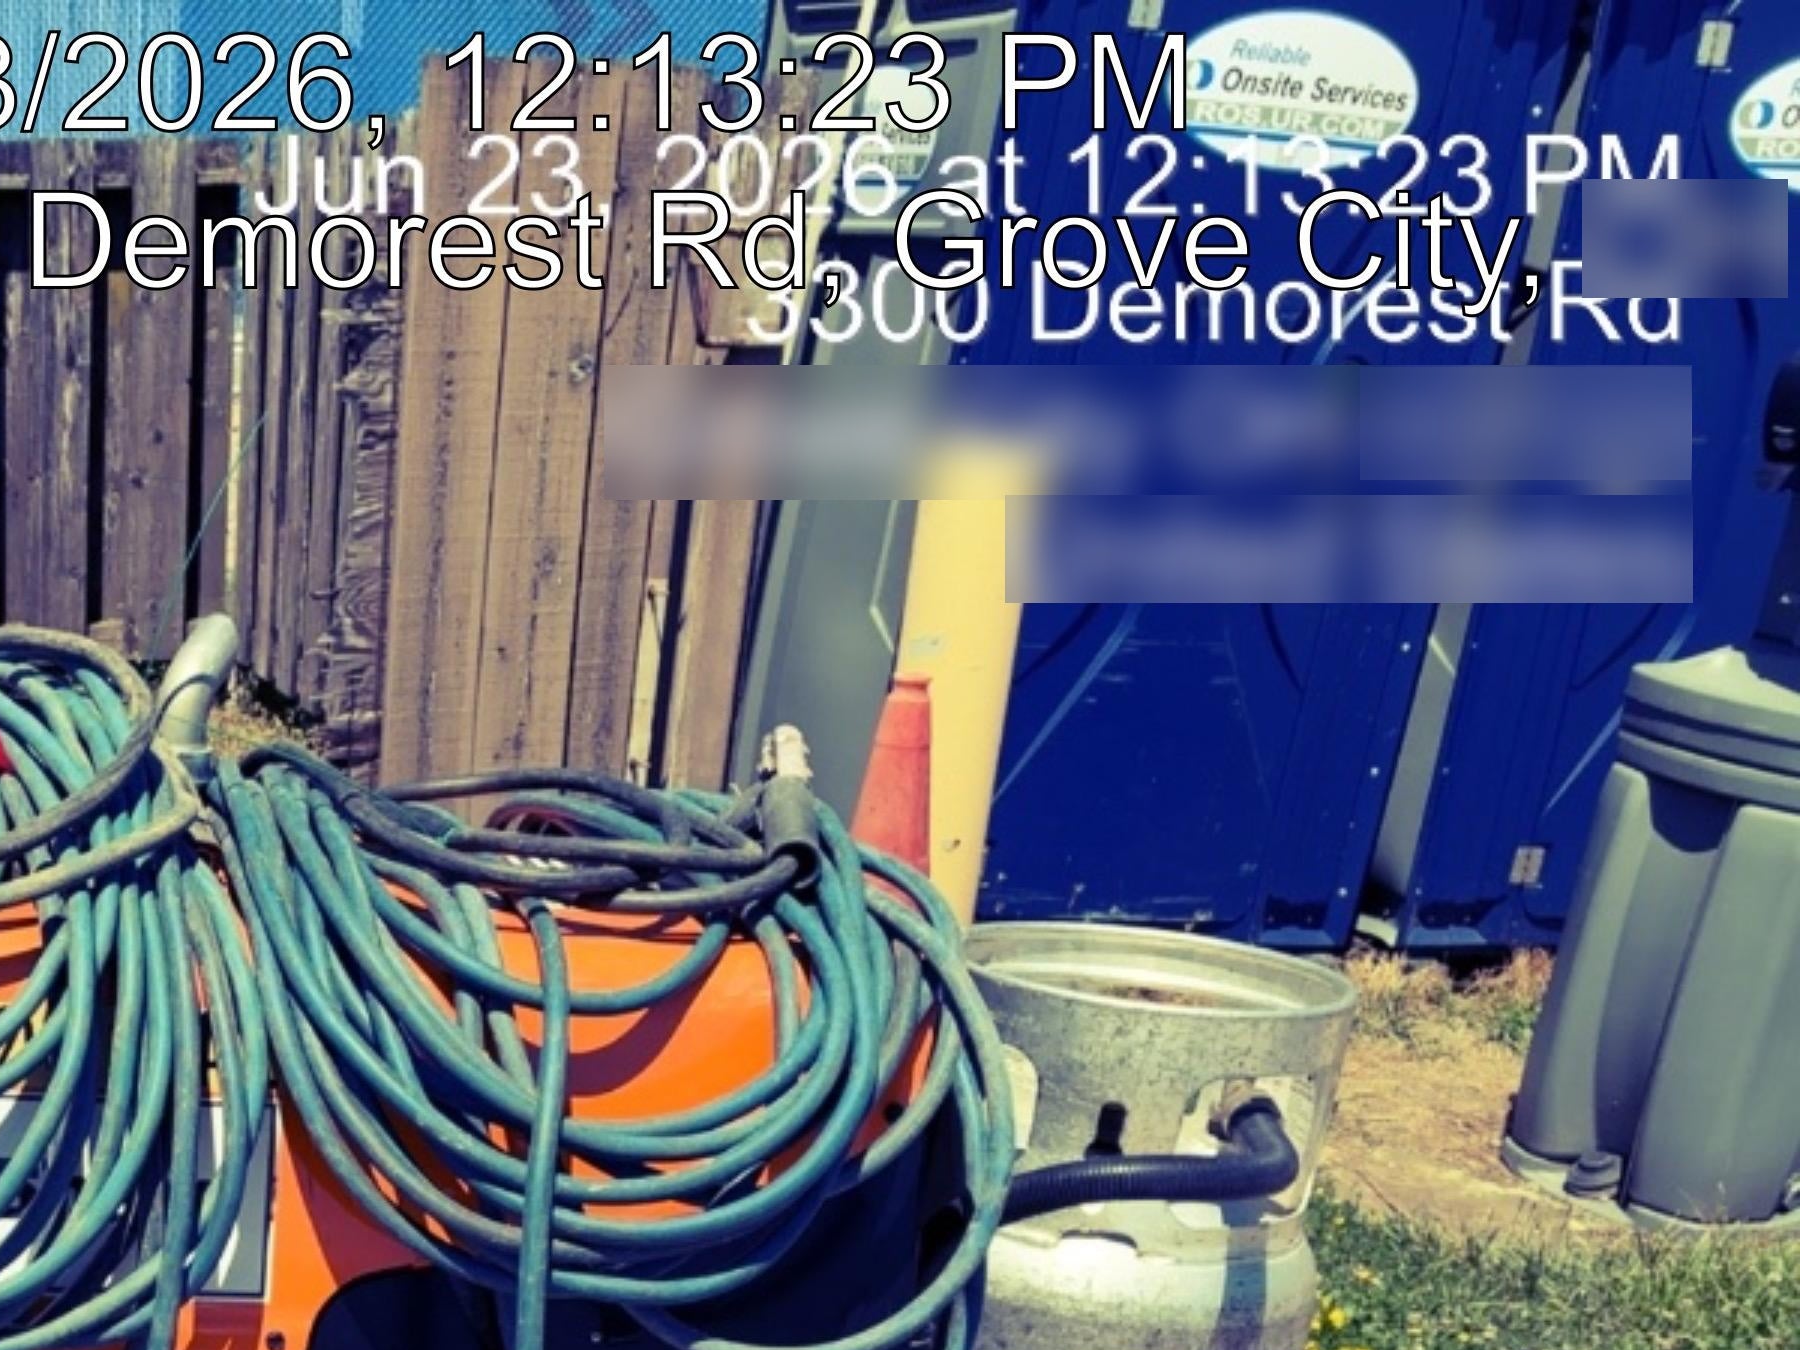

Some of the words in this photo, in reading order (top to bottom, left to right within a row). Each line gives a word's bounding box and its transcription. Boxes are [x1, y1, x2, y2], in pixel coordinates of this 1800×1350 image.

[1230, 38, 1312, 66] Reliable
[1221, 66, 1304, 99] Onsite
[1310, 76, 1410, 113] Services
